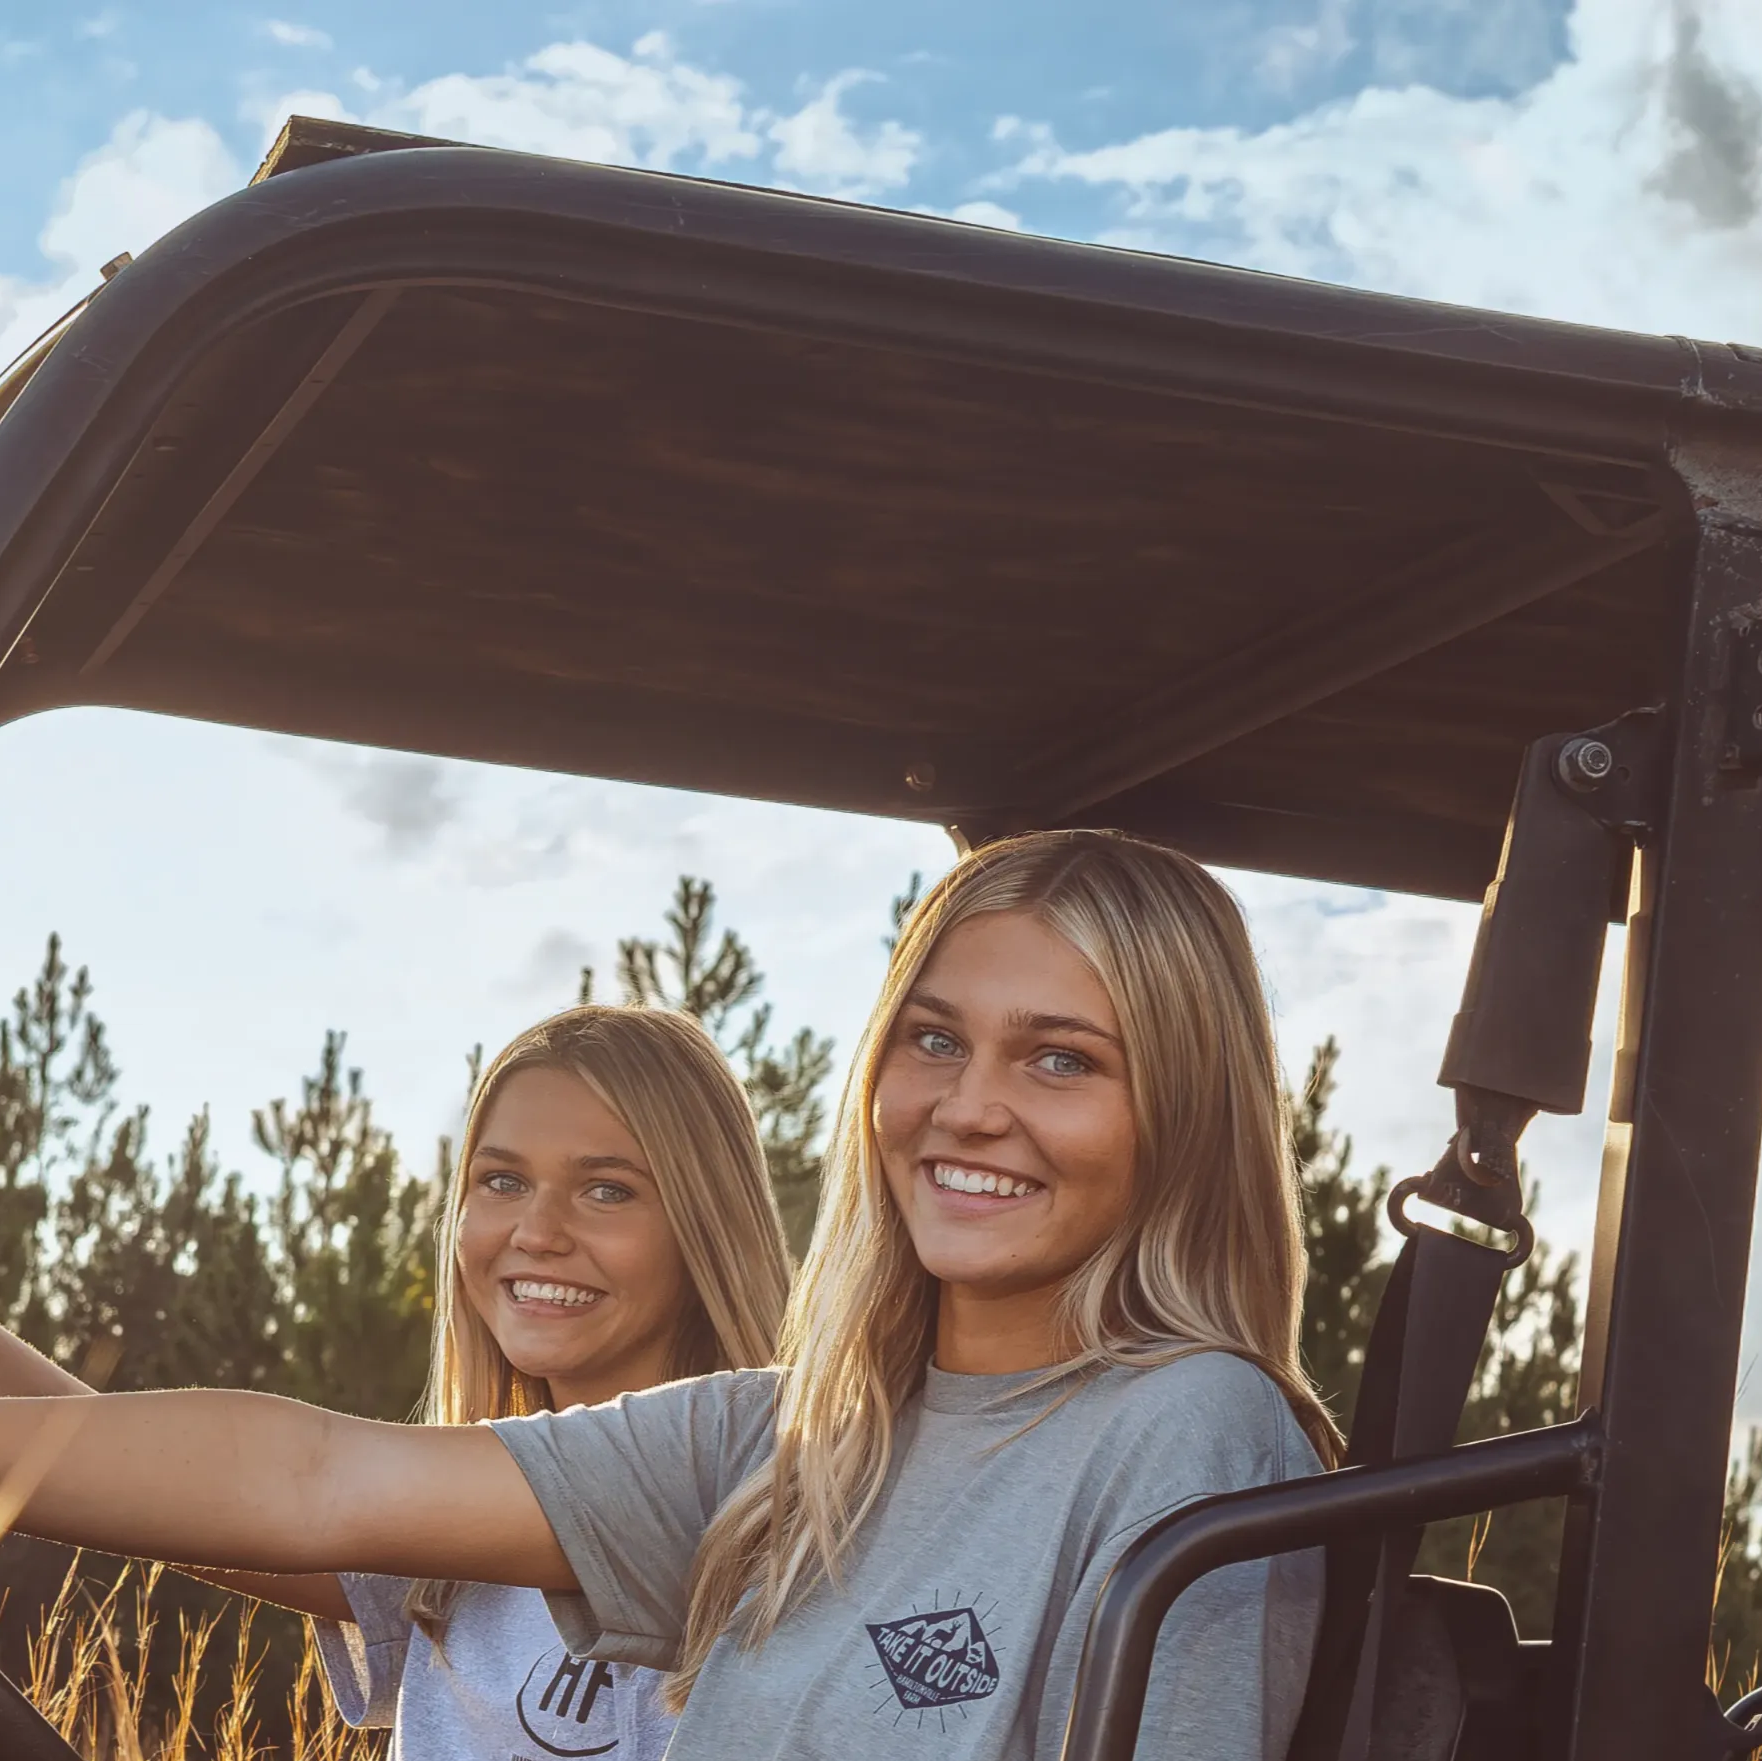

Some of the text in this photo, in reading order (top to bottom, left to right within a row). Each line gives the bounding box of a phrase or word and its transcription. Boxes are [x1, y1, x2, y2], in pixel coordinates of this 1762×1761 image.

[877, 1627, 998, 1694] TAKE IT OUTSIDE
